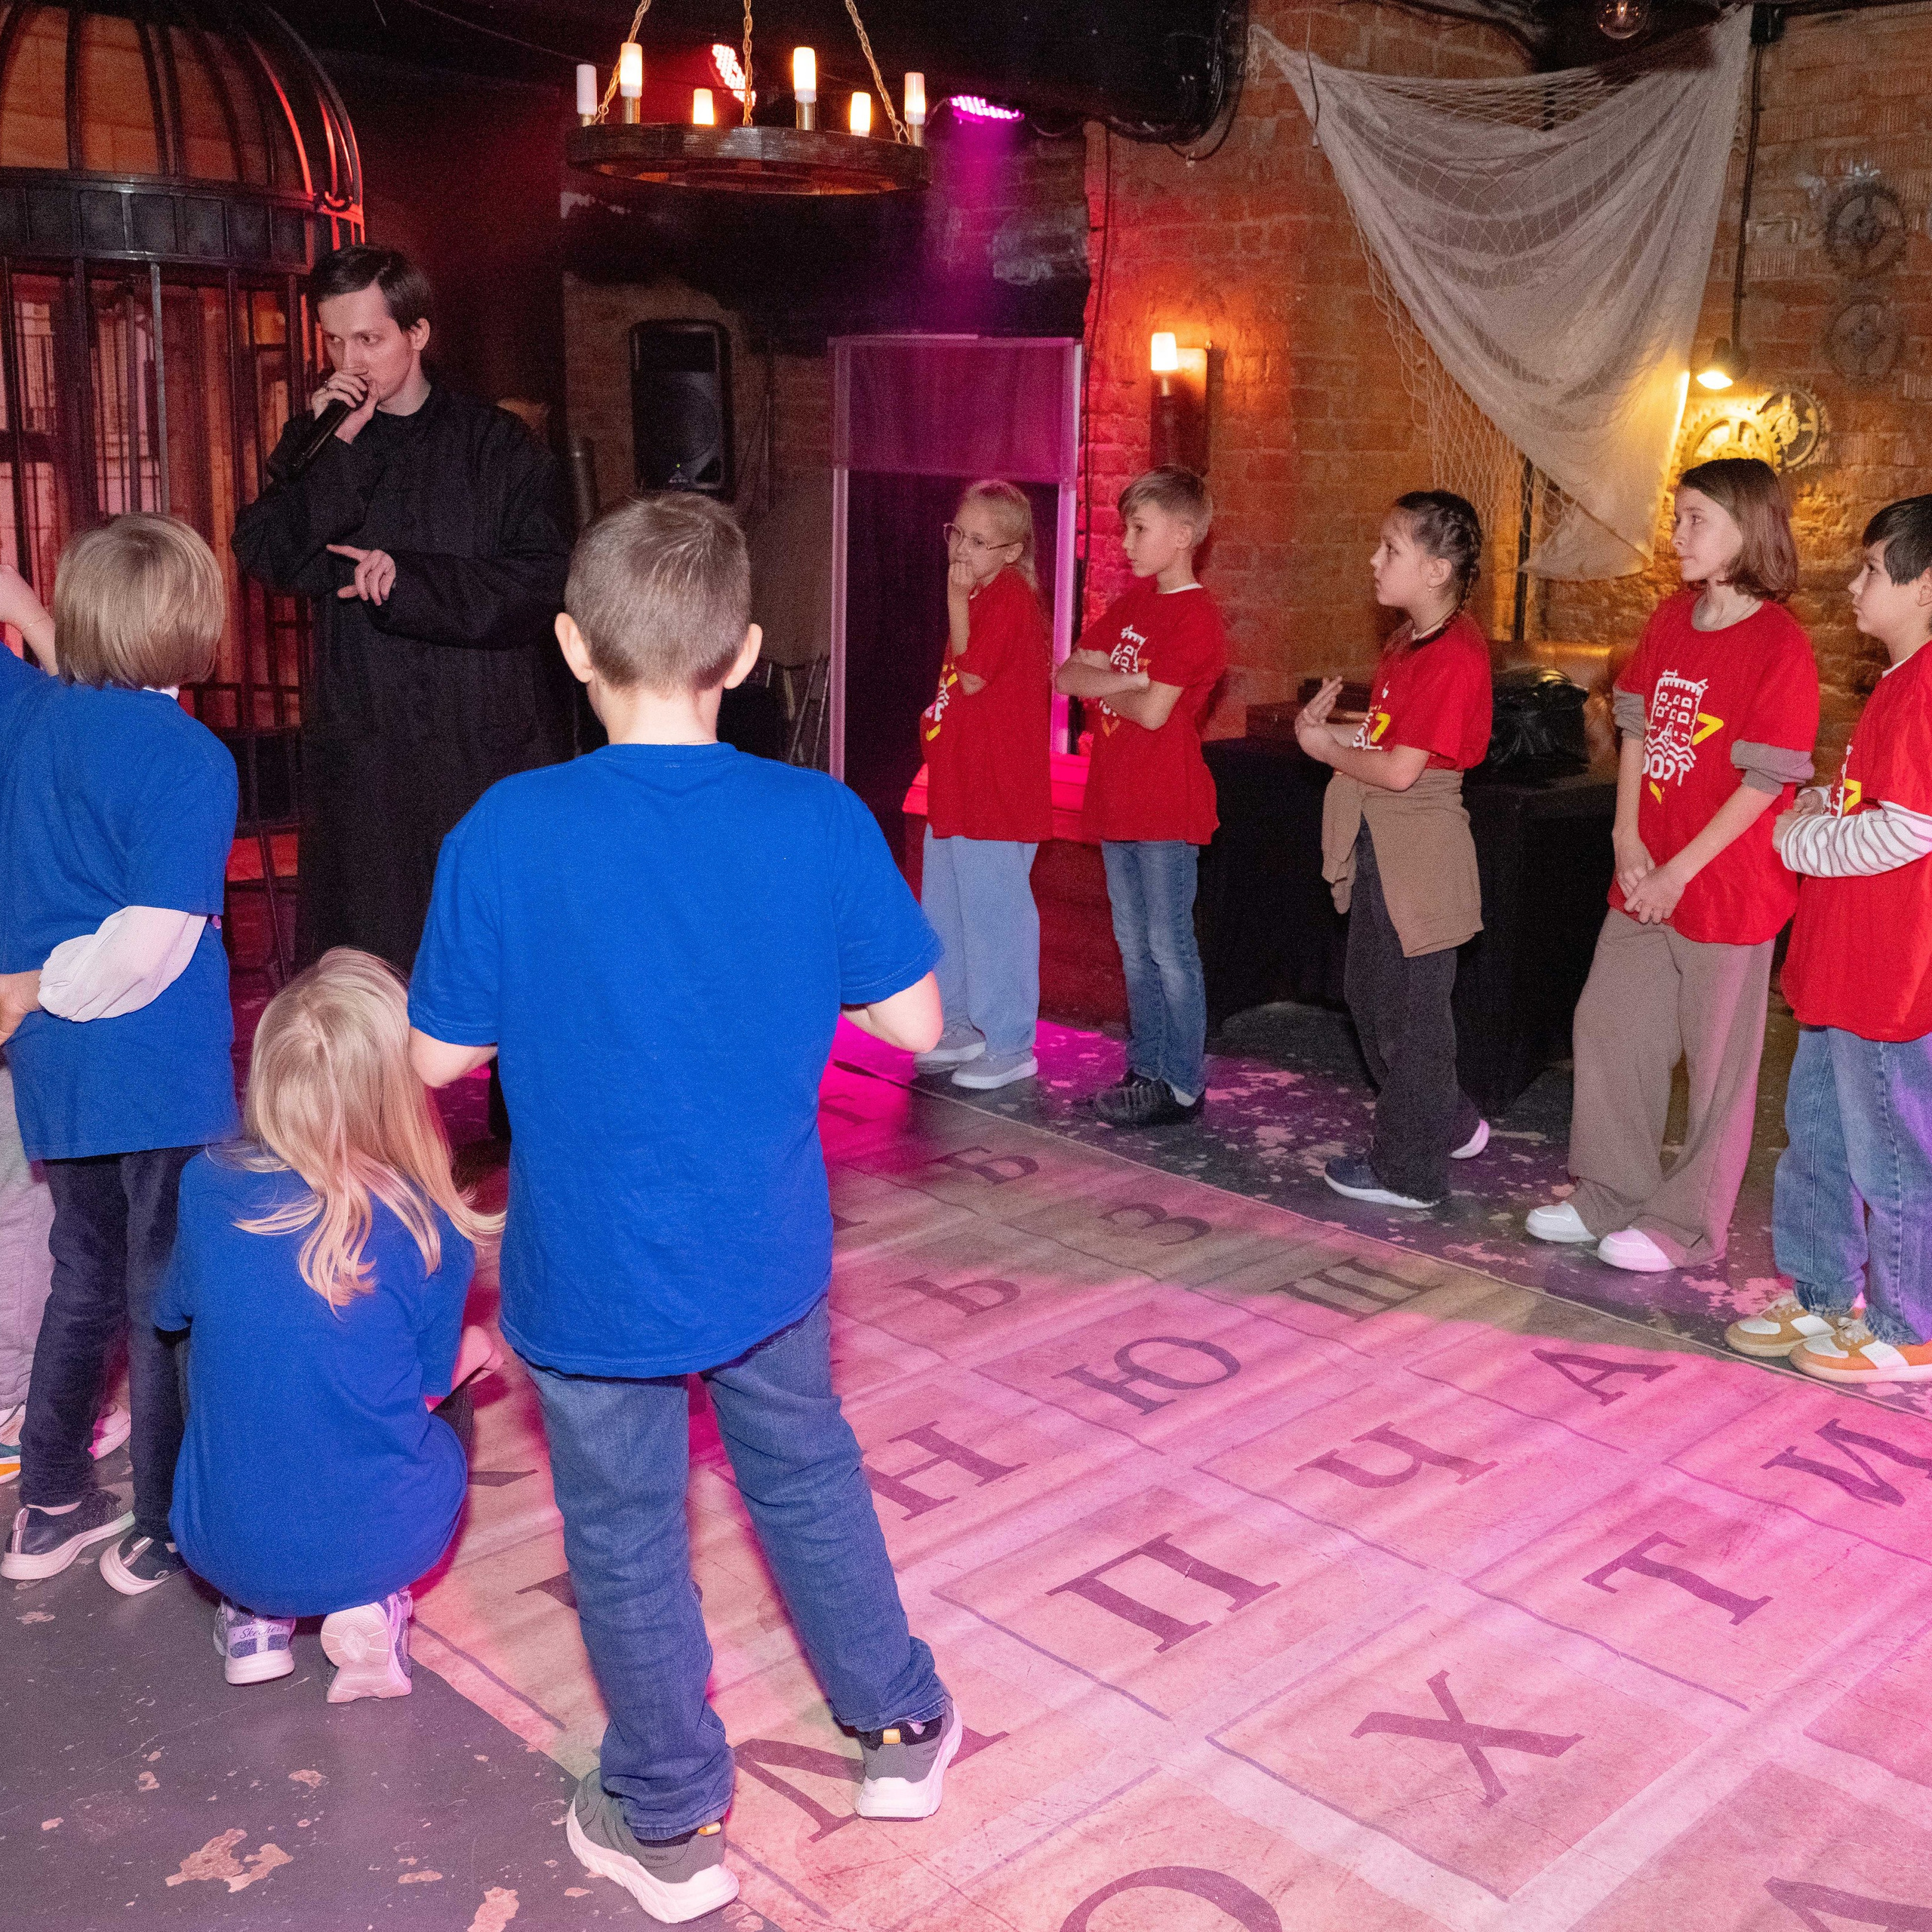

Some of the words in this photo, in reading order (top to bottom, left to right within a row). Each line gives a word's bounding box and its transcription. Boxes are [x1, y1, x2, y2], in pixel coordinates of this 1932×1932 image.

[925, 1146, 1040, 1186] Б
[1098, 1201, 1212, 1247] З
[888, 1273, 1021, 1318] Ь
[1268, 1256, 1444, 1322] Ш
[1051, 1336, 1241, 1417] Ю
[1531, 1347, 1678, 1406] А
[863, 1420, 1029, 1521] Н
[1294, 1421, 1500, 1489] Ч
[1759, 1418, 1932, 1508] И
[1044, 1532, 1281, 1653] П
[1582, 1531, 1774, 1627] Т
[1349, 1669, 1585, 1808] Х
